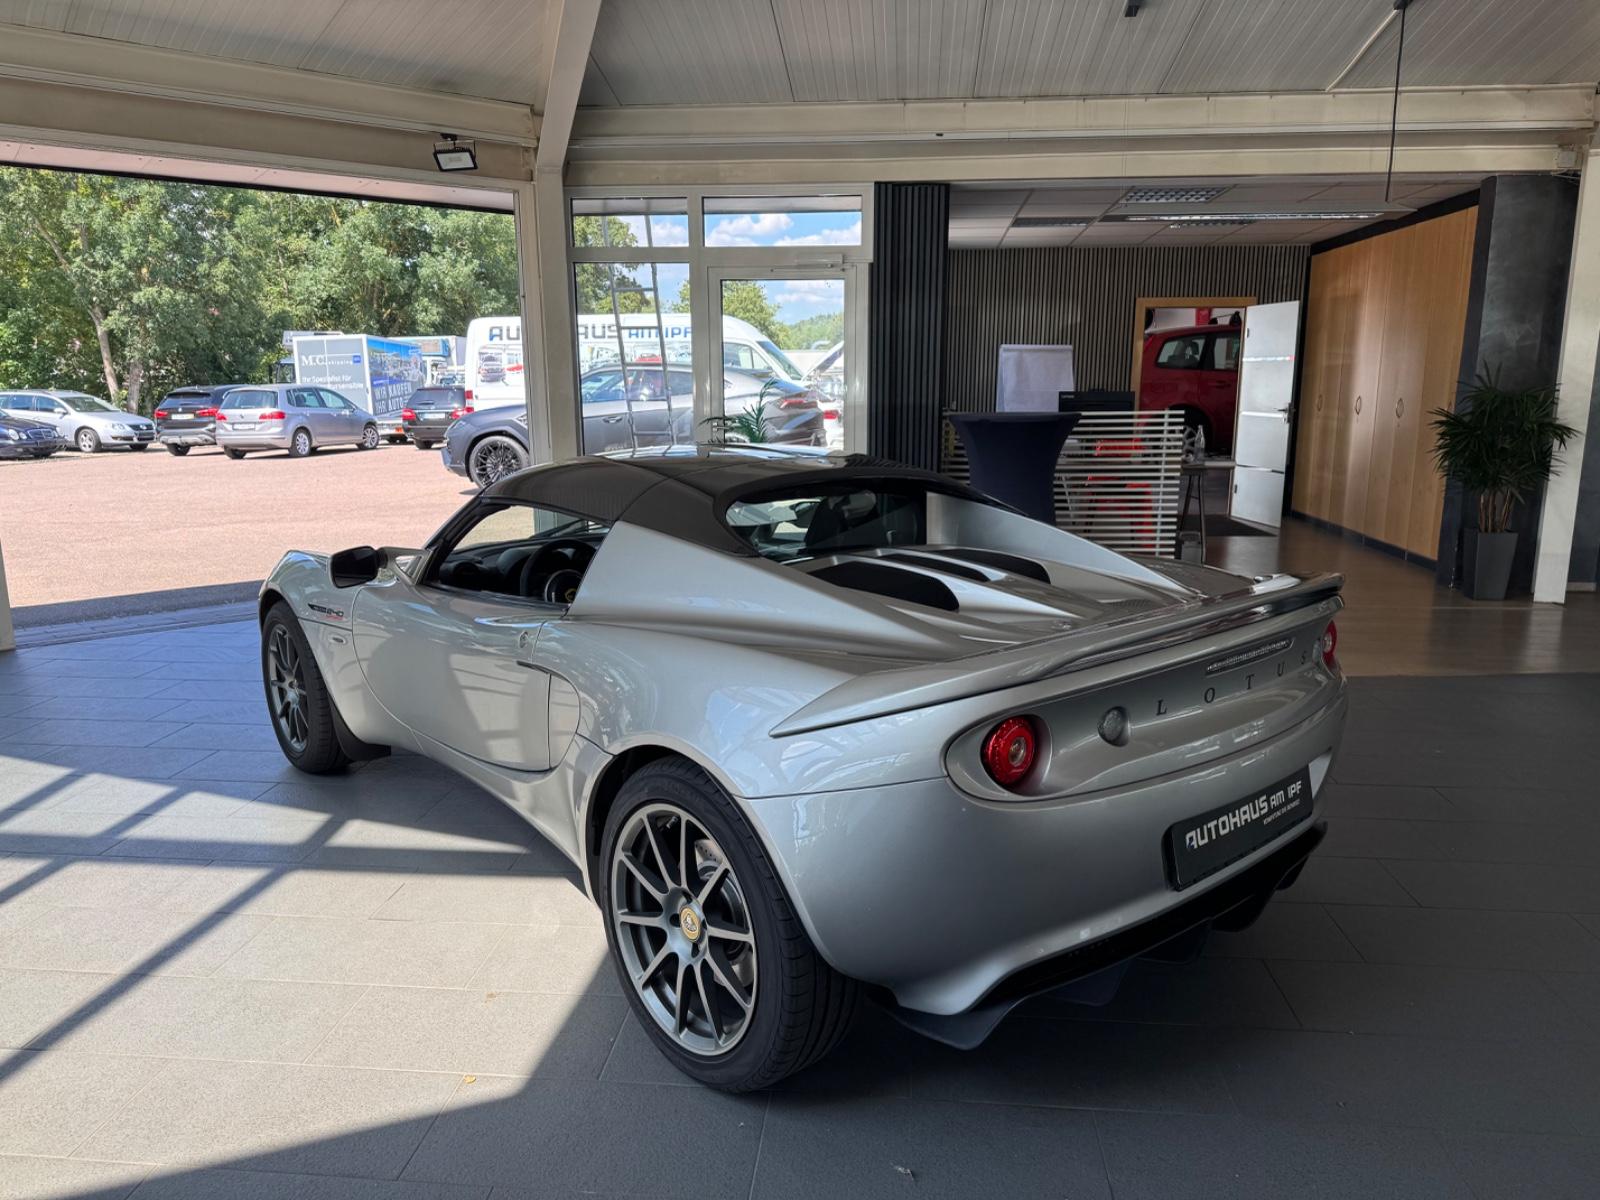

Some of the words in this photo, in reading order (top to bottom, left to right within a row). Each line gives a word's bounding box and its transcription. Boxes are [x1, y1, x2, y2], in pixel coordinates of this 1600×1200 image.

[1155, 653, 1307, 717] LOTUS
[1185, 794, 1269, 850] AUTOHAUS
[1269, 789, 1285, 810] AM
[1287, 780, 1302, 799] IPF
